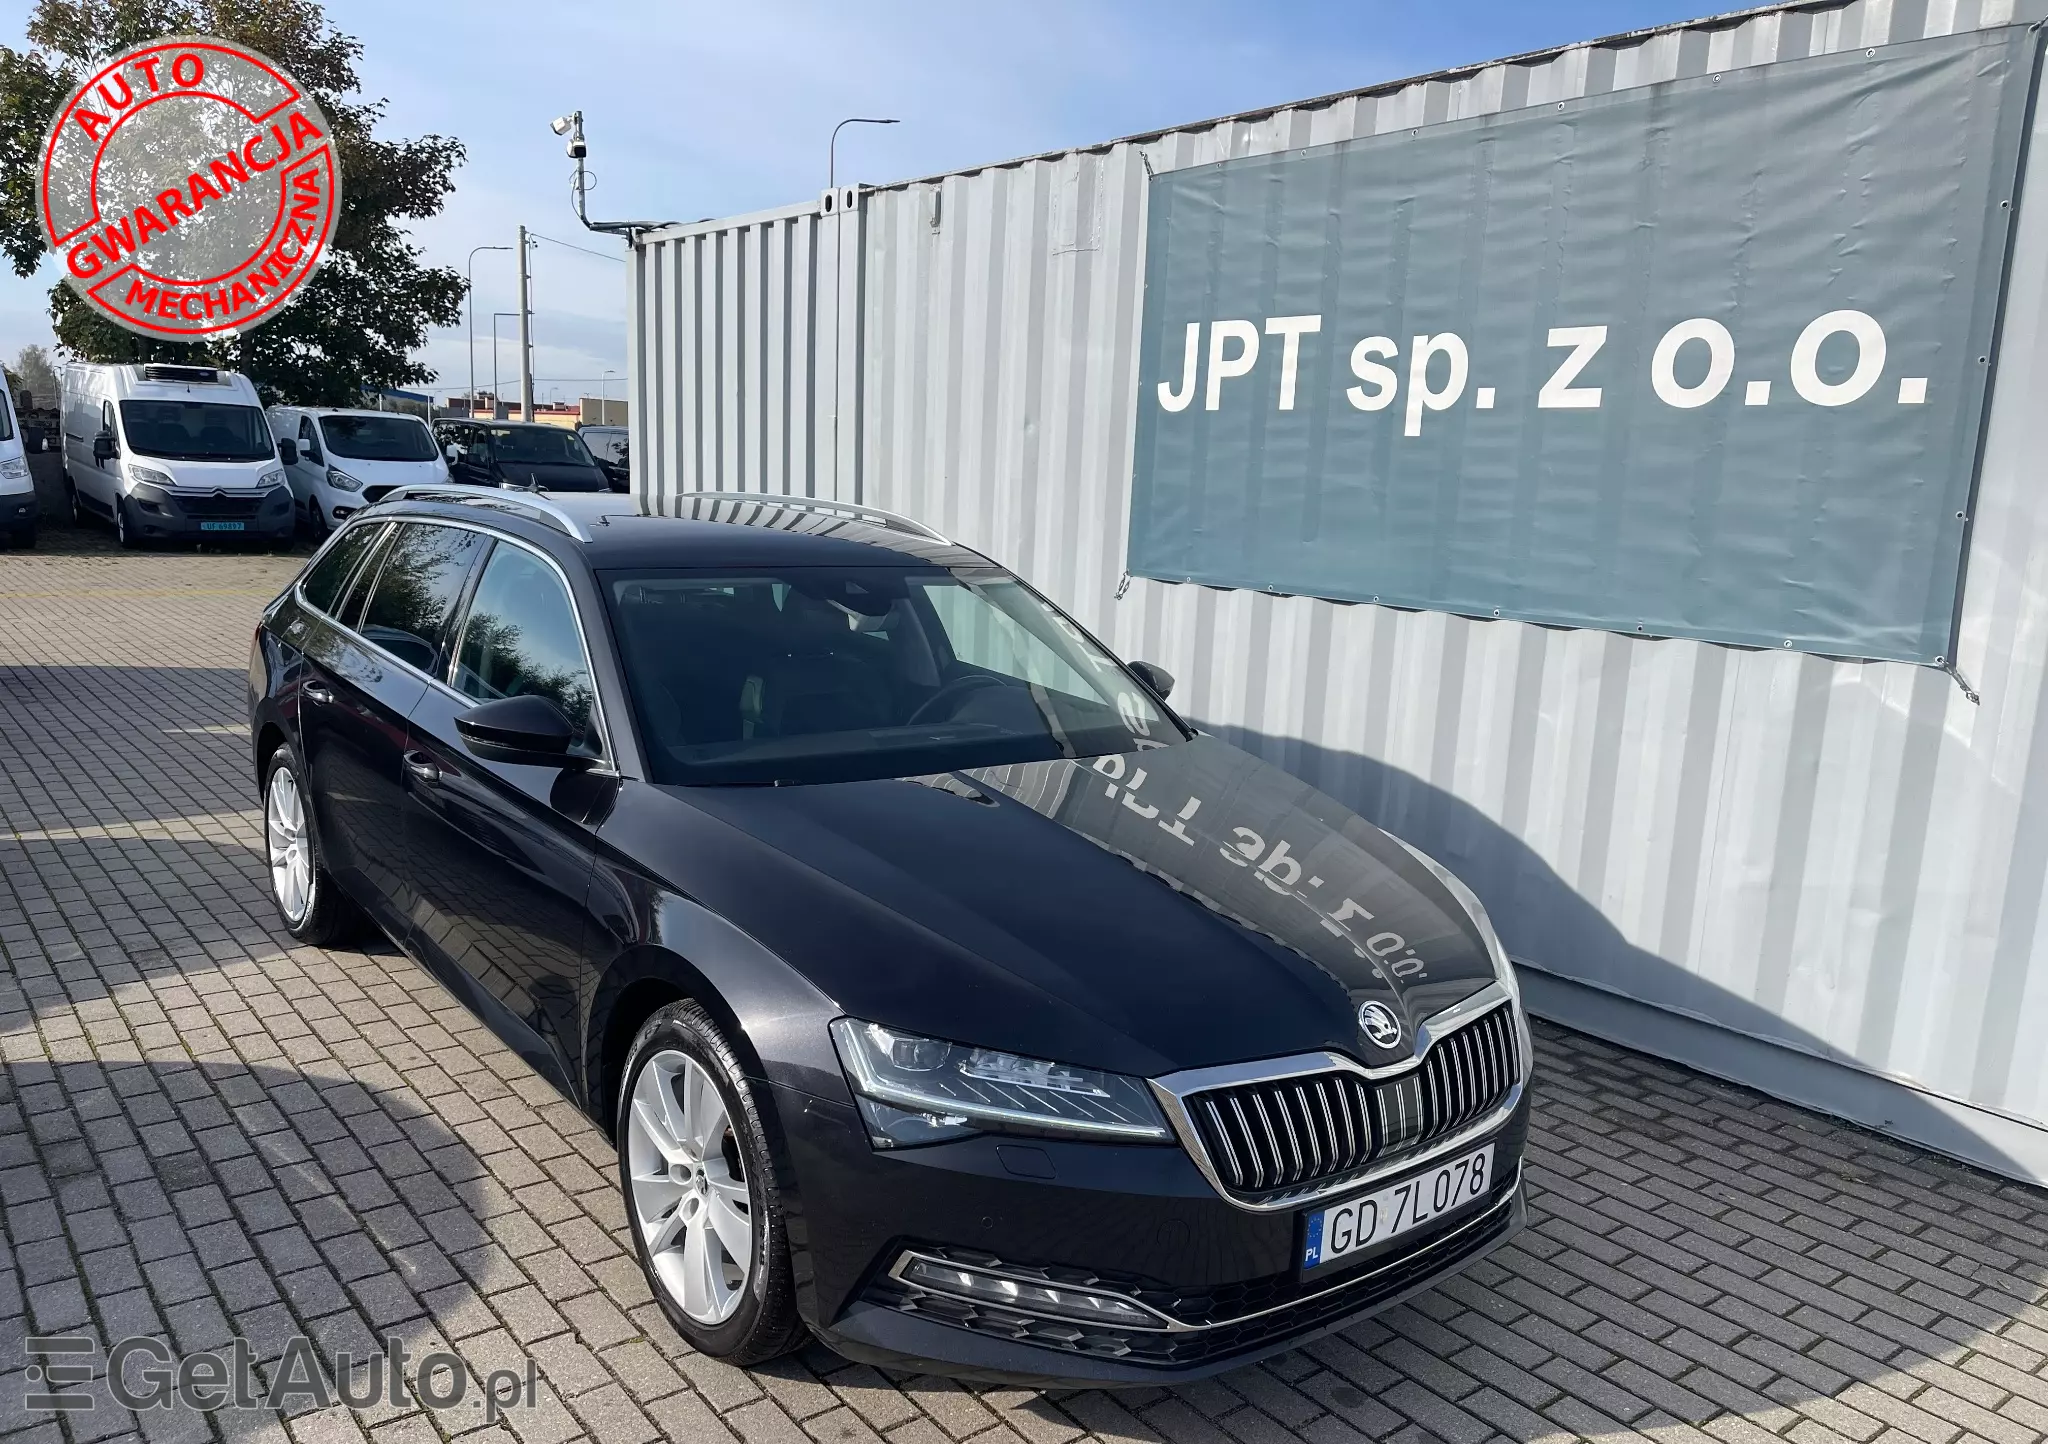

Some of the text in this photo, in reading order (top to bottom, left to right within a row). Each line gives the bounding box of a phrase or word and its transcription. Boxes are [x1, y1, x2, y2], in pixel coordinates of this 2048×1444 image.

[1158, 310, 1928, 436] JPT sp. z o.o.
[1330, 1153, 1486, 1254] GD 7L078
[1305, 1247, 1319, 1262] PL
